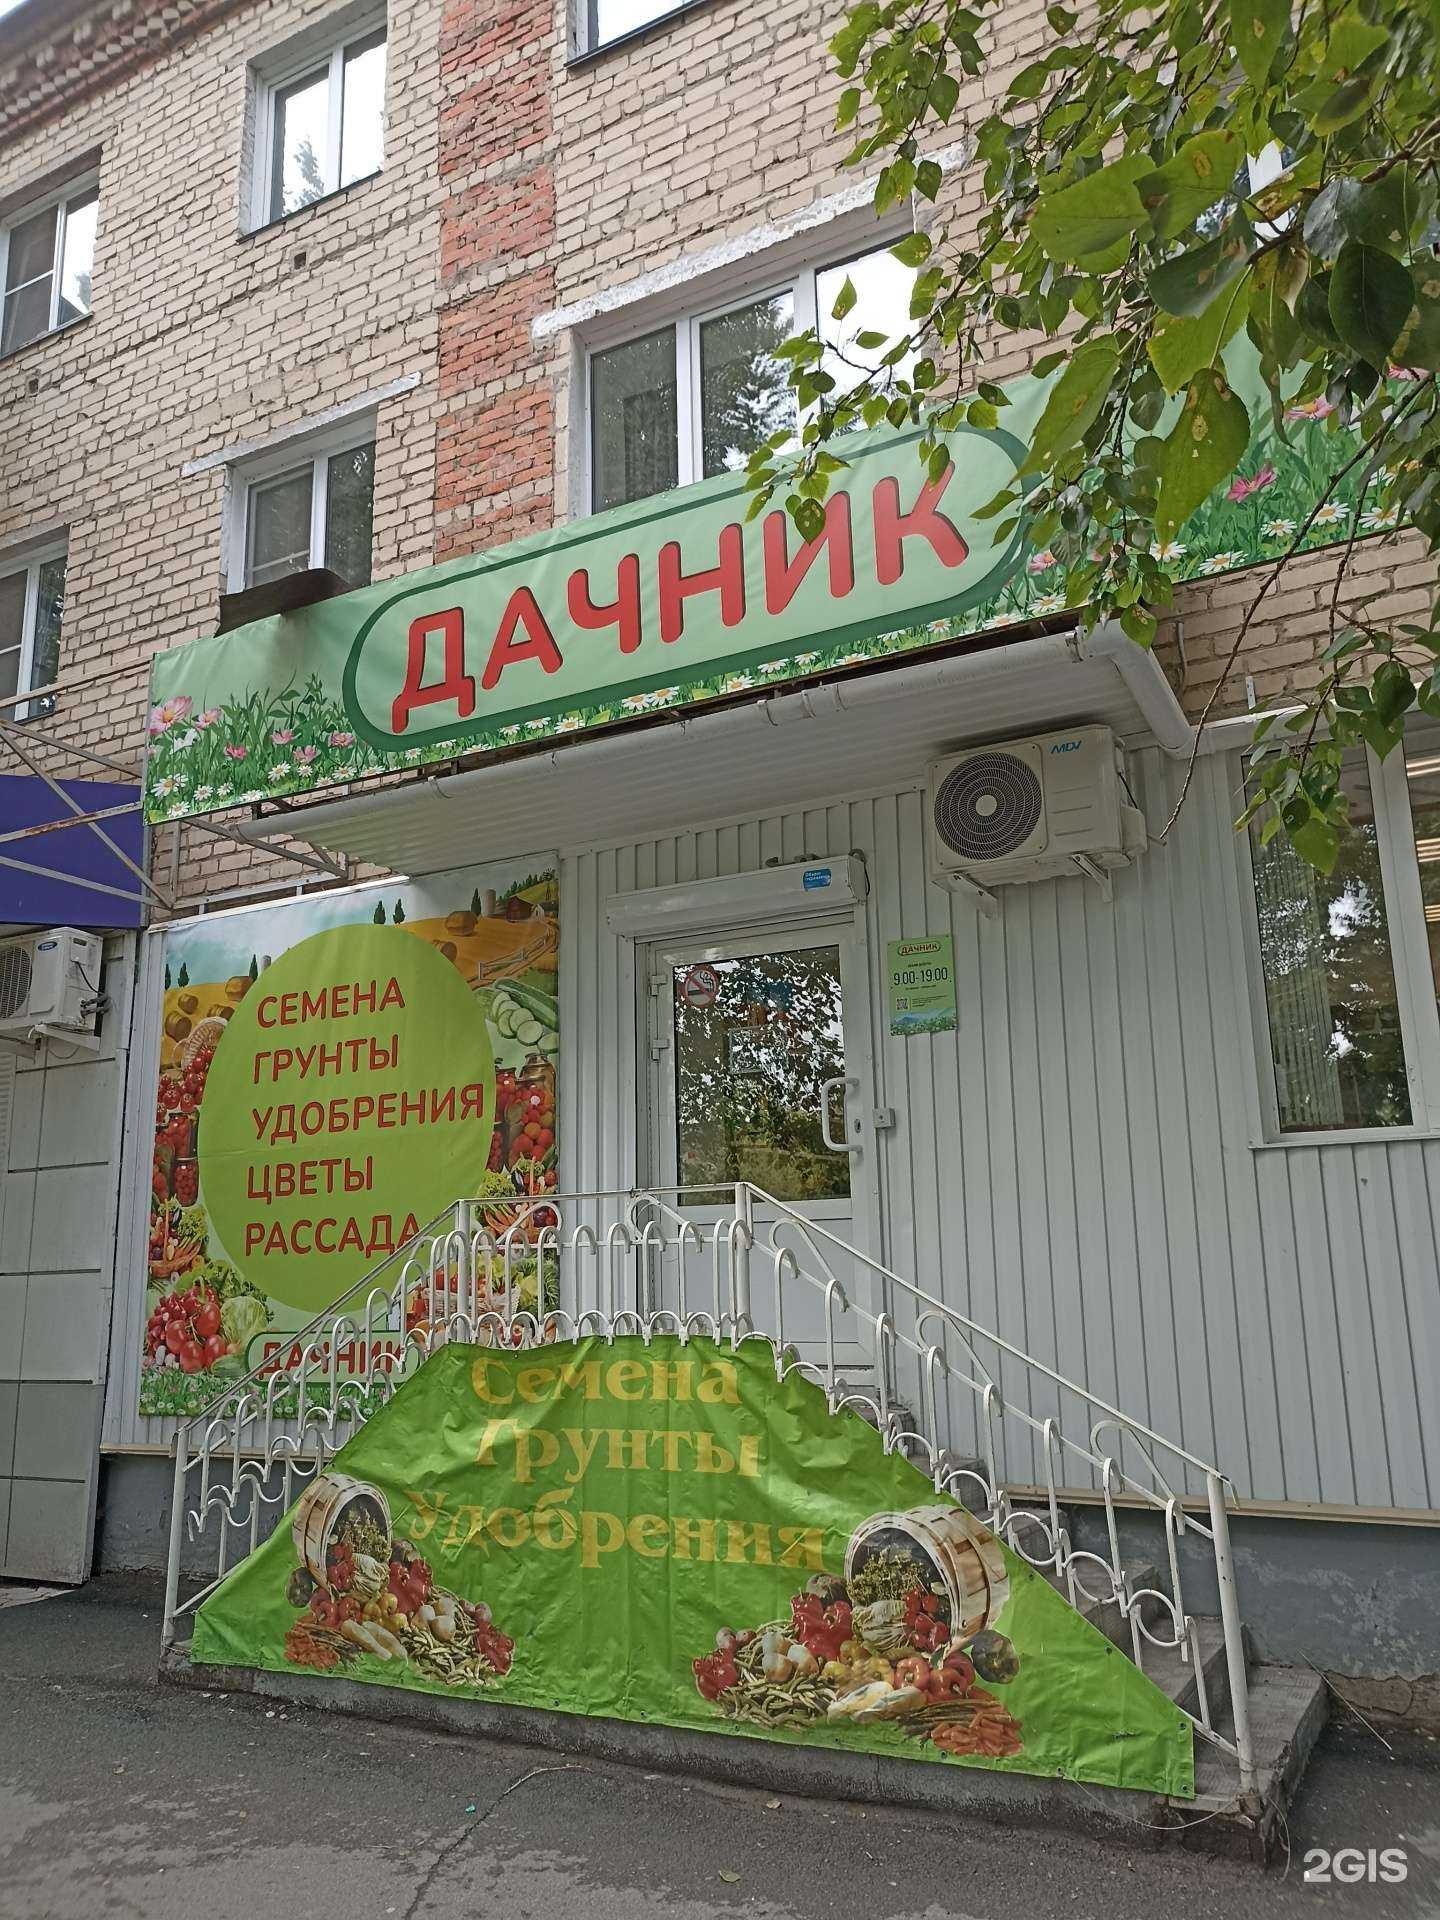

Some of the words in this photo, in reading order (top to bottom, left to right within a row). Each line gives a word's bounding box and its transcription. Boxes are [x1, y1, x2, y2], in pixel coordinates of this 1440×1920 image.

[391, 460, 969, 734] ДАЧНИК
[902, 943, 938, 954] ДАЧНИК
[257, 977, 405, 1028] СЕМЕНА
[253, 1034, 399, 1084] ГРУНТЫ
[252, 1083, 484, 1145] УДОБРЕНИЯ
[248, 1155, 373, 1203] ЦВЕТЫ
[245, 1212, 420, 1259] РАССАДА
[470, 1358, 742, 1406] Семена
[474, 1418, 763, 1484] Грунты
[406, 1489, 827, 1571] Удобрения
